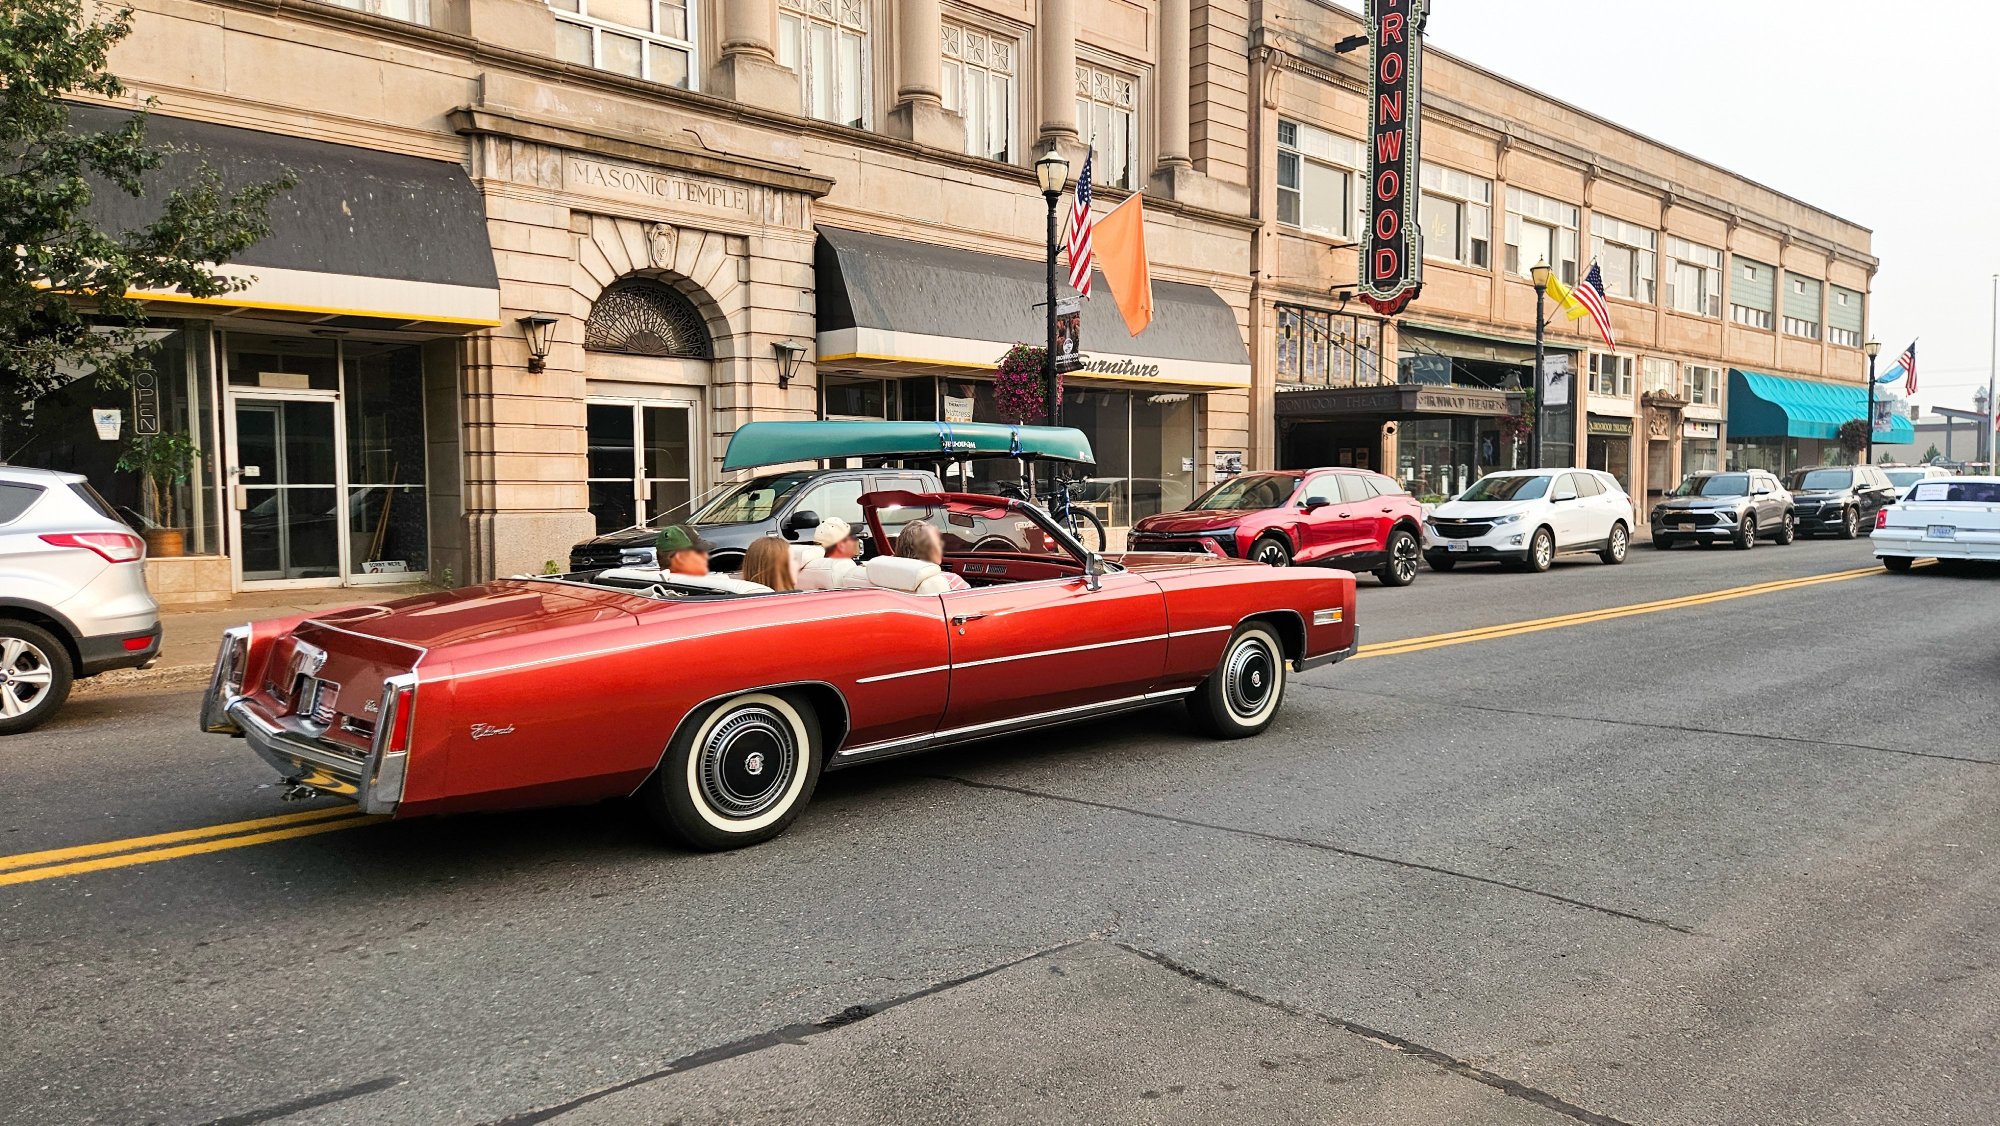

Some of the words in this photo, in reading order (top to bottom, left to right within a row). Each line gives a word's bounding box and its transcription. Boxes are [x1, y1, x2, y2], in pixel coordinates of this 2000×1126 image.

[1375, 0, 1404, 280] RONWOOD
[574, 162, 669, 197] MASONIC
[673, 180, 744, 210] TEMPLE
[137, 372, 156, 431] OPEN
